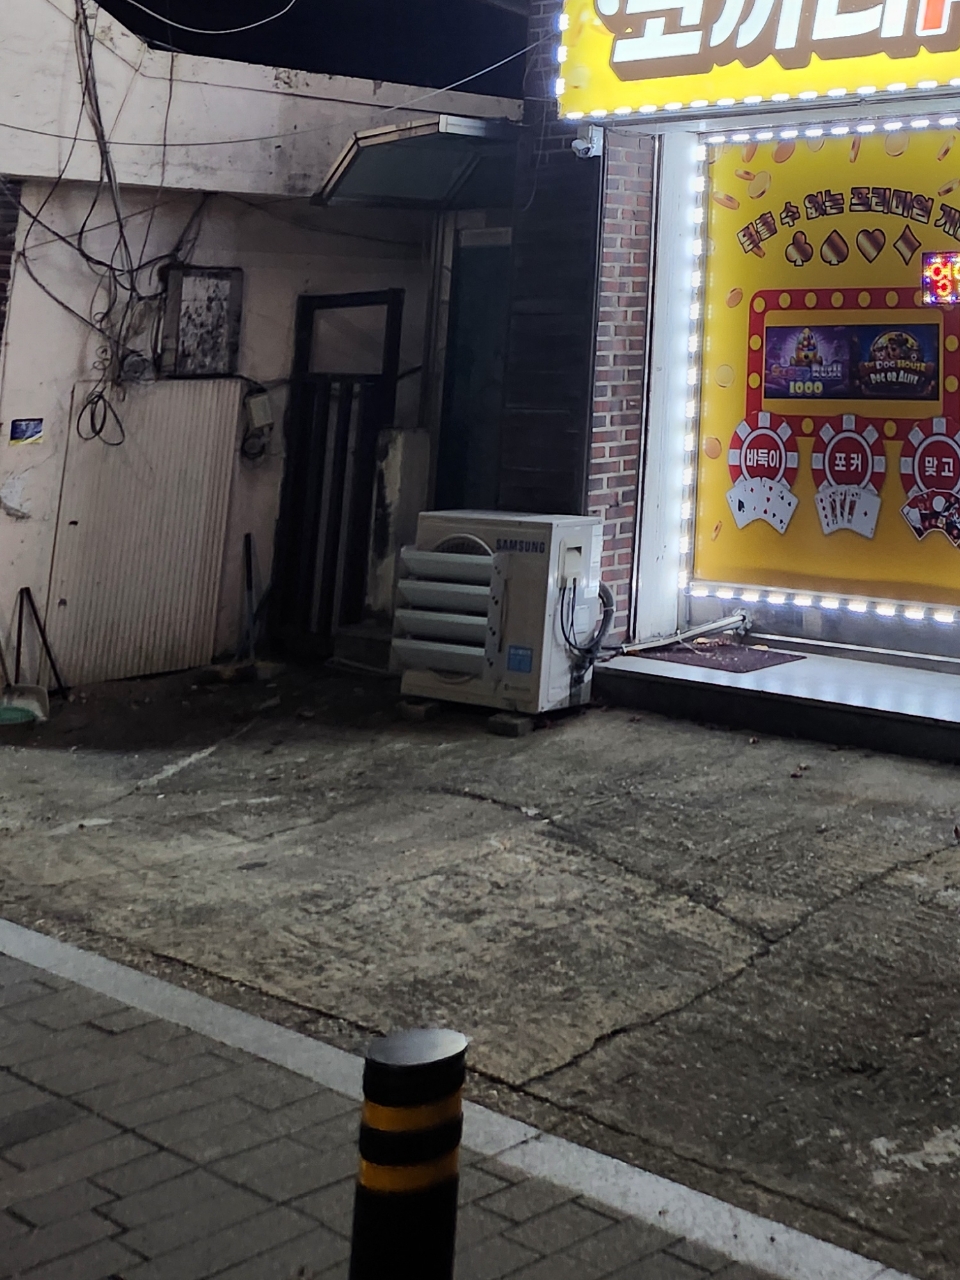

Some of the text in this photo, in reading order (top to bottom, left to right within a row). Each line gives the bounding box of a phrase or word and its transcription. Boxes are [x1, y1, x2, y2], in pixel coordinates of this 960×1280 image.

[780, 201, 801, 227] 수
[803, 189, 845, 220] 없는
[849, 187, 935, 224] 프리미엄
[789, 380, 824, 395] 1000
[746, 448, 781, 469] 바둑이
[495, 538, 546, 554] SAMSUNG
